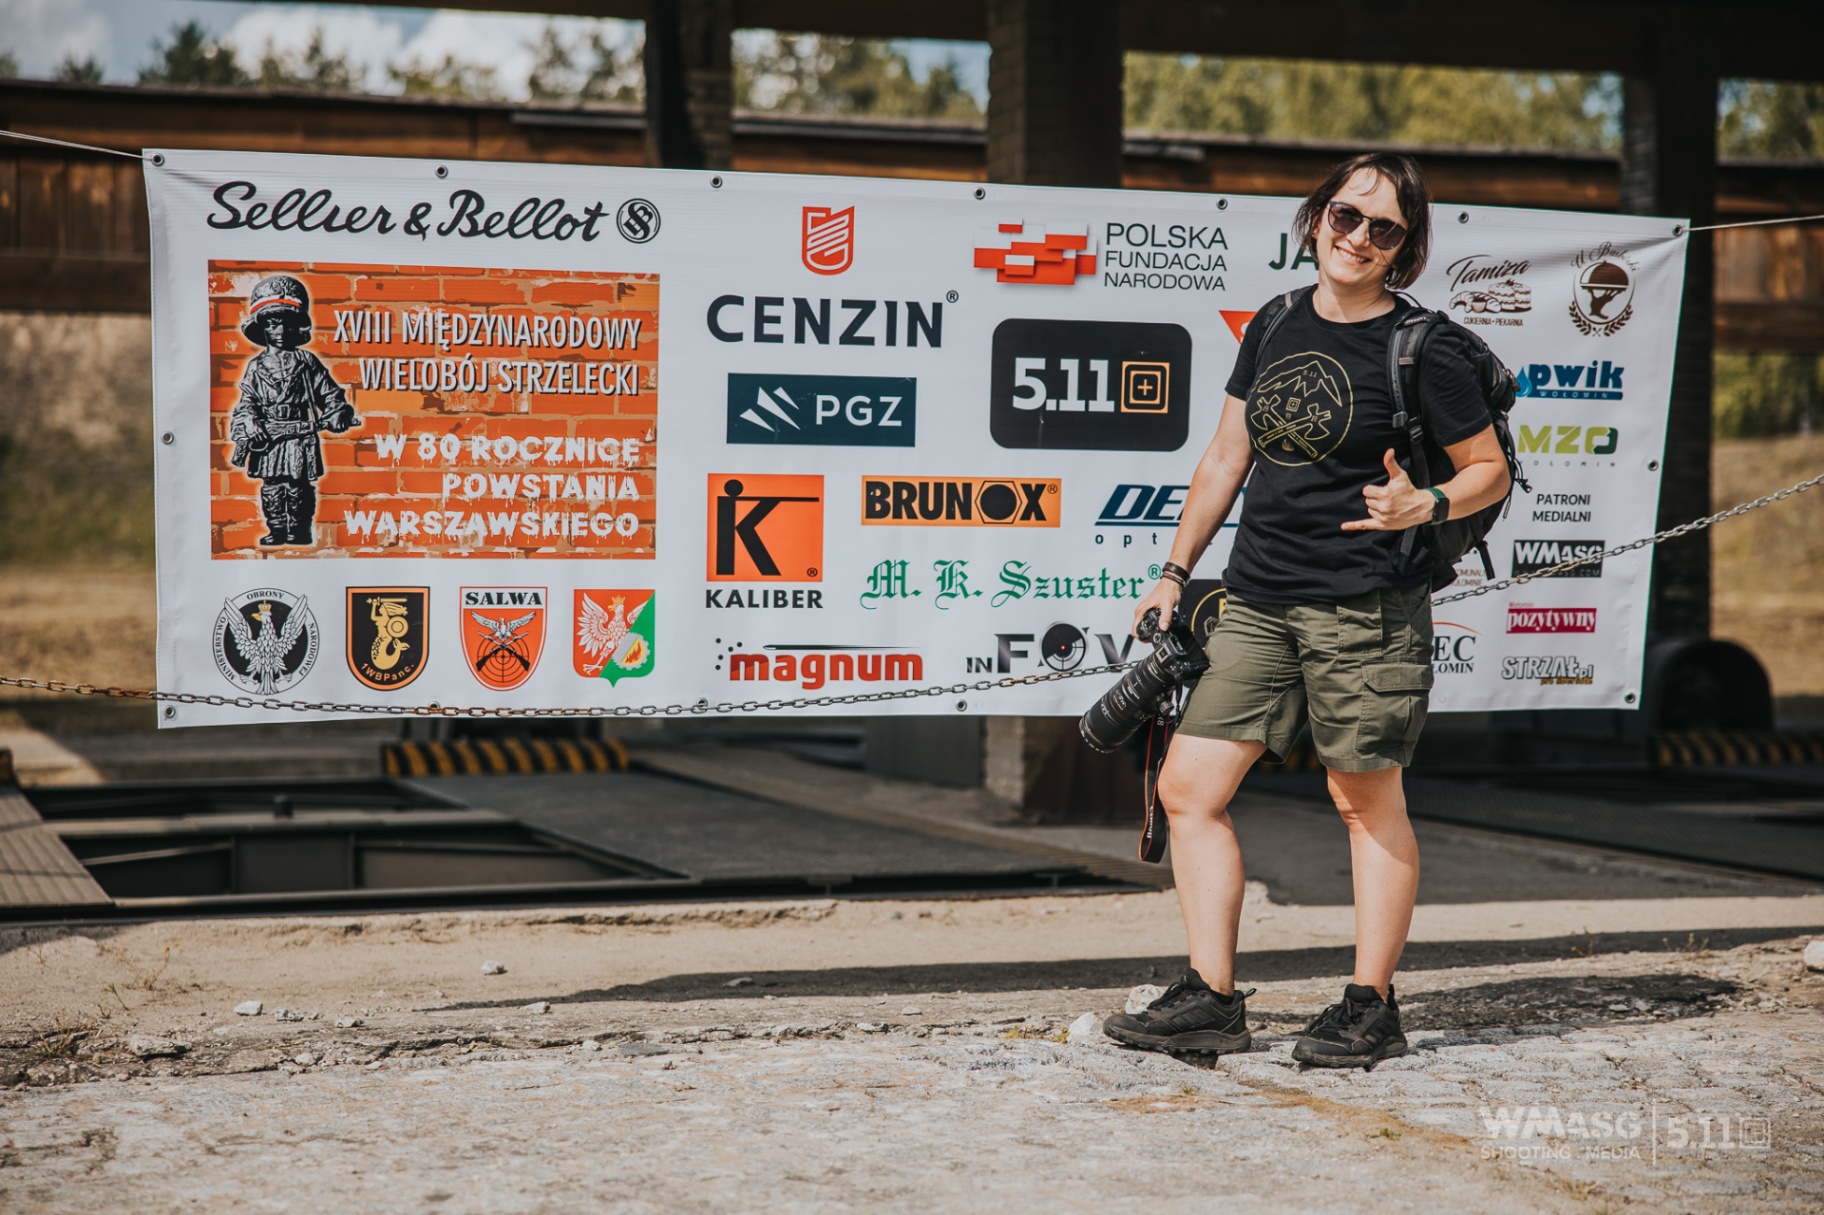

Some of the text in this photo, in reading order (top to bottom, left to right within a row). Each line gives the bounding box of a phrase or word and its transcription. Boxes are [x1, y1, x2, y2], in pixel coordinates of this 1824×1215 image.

[403, 202, 433, 242] &
[436, 188, 610, 242] Bellot
[1106, 222, 1229, 250] POLSKA
[1105, 250, 1228, 272] FUNDACJA
[1446, 254, 1532, 292] Tamiza
[1103, 272, 1227, 292] NARODOWA
[333, 310, 643, 352] XVIII MIĘDZYNARODOWY
[706, 294, 943, 348] CENZIN
[359, 352, 641, 396] WIELOBÓJ STRZELECKI
[1012, 356, 1116, 413] 5.11
[1527, 360, 1625, 398] pwik
[815, 394, 903, 428] PGZ
[374, 433, 408, 462] W
[418, 434, 461, 464] 80
[1517, 425, 1619, 455] MZO
[442, 472, 640, 504] POWSTANIA
[1536, 493, 1592, 506] PATRONI
[343, 509, 640, 540] WARSZAWSKIEGO
[1532, 510, 1592, 523] MEDIALNI
[246, 590, 285, 600] OBRONY
[464, 590, 543, 606] SALWA
[705, 589, 824, 610] KALIBER
[990, 560, 1146, 608] Szuster
[1506, 609, 1597, 633] pozytywny
[214, 616, 238, 681] MINISTERSTWO
[298, 622, 318, 677] NARODOWEJ
[729, 652, 925, 691] magnum
